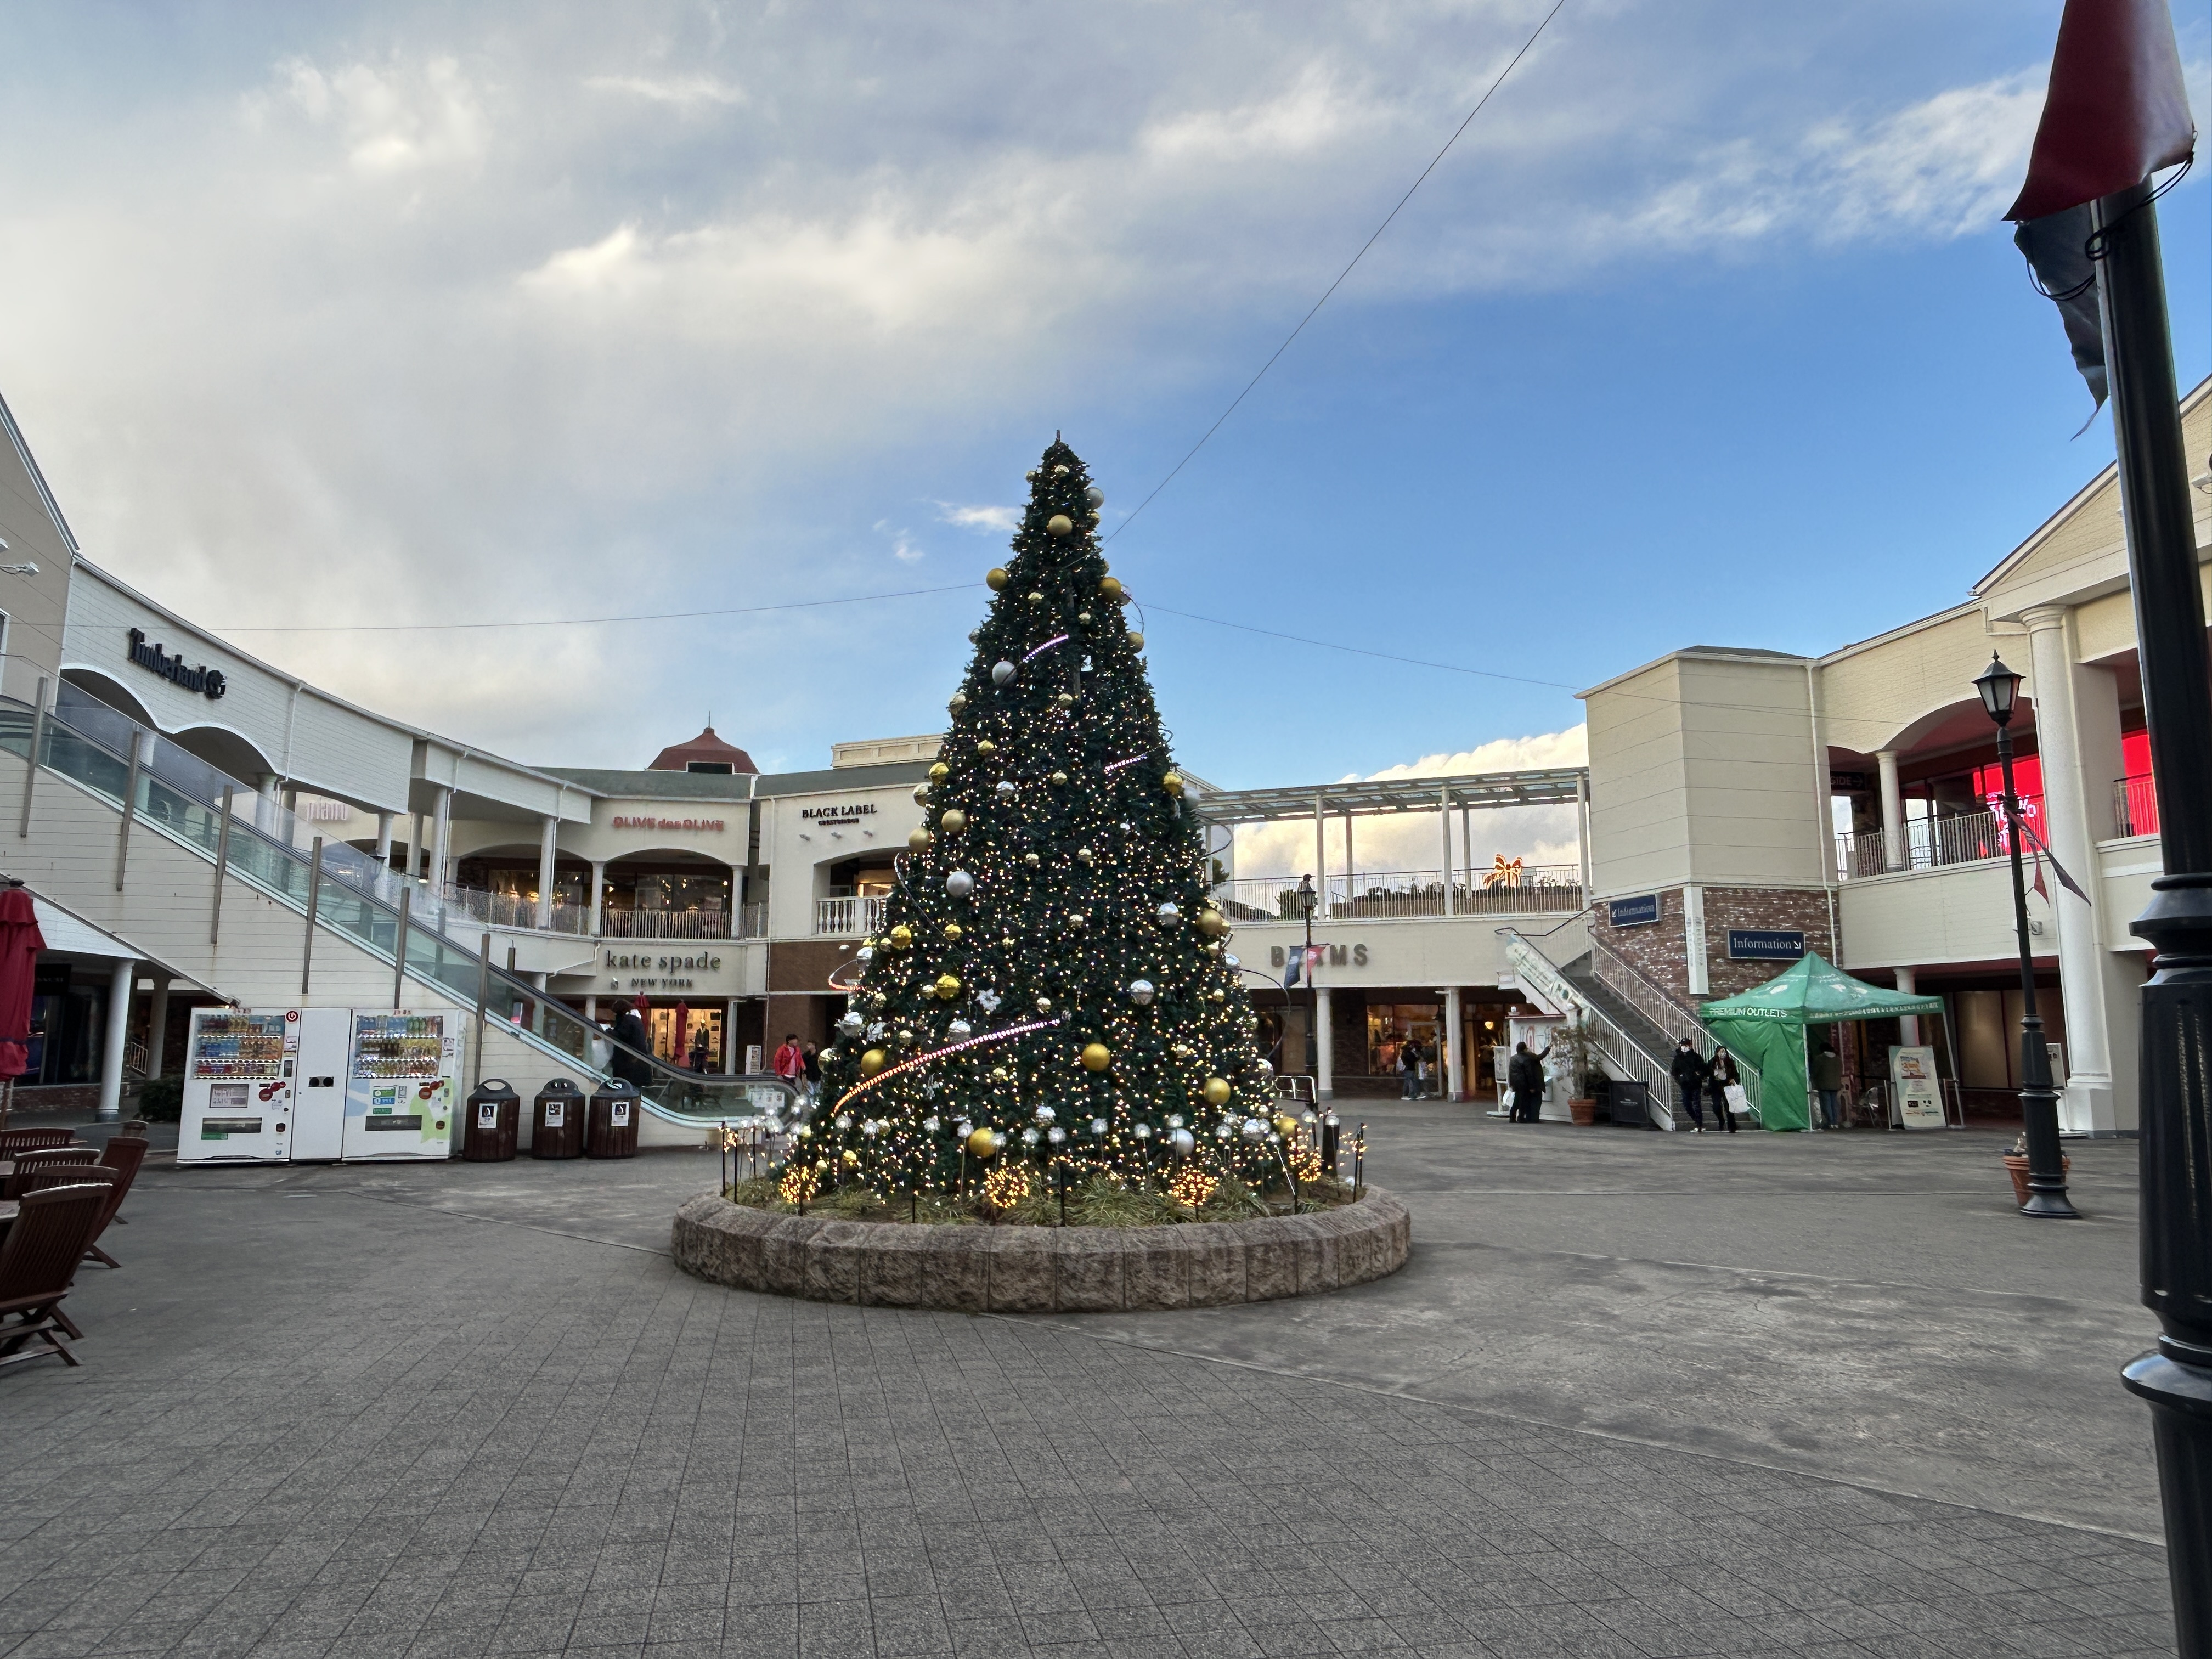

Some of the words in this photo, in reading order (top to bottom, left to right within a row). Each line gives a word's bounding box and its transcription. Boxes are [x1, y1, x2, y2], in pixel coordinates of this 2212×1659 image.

[129, 628, 206, 692] Timberland
[802, 806, 838, 818] BLACK
[841, 804, 877, 815] LABEL
[613, 816, 656, 828] OLIVE
[1734, 938, 1791, 949] Information
[606, 950, 651, 968] kate
[658, 951, 721, 974] spade
[1271, 944, 1368, 967] BMS
[631, 978, 656, 987] NEW
[662, 979, 692, 988] YORK
[1709, 1007, 1746, 1015] PREMIUM
[1747, 1007, 1787, 1018] OUTLETS
